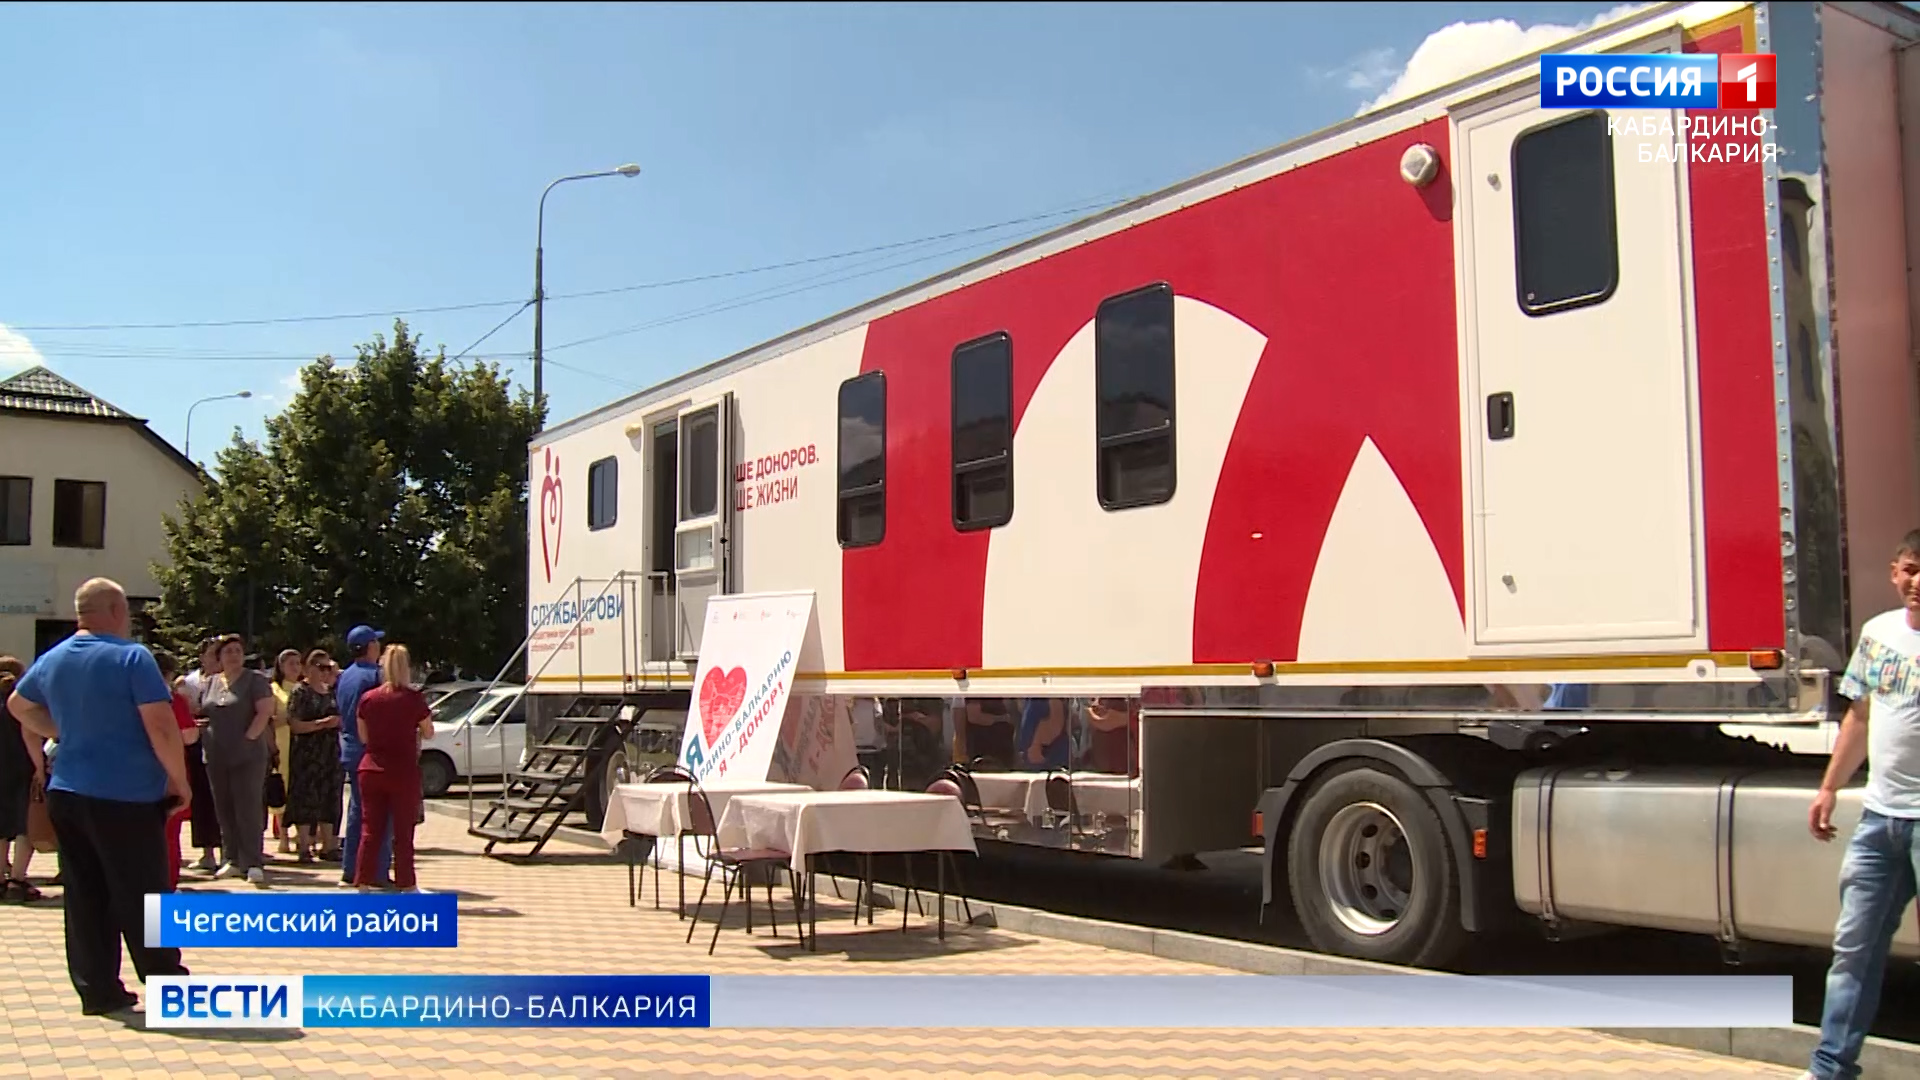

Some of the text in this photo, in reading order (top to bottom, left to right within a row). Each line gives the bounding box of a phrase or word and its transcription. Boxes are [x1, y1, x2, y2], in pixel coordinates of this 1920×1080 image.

[756, 444, 819, 481] ДОНОРОВ.
[756, 476, 798, 507] ЖИЗНИ
[531, 594, 623, 627] СЛУЖБА КРОВИ
[719, 758, 728, 777] Я
[739, 680, 786, 753] ДОНОР!
